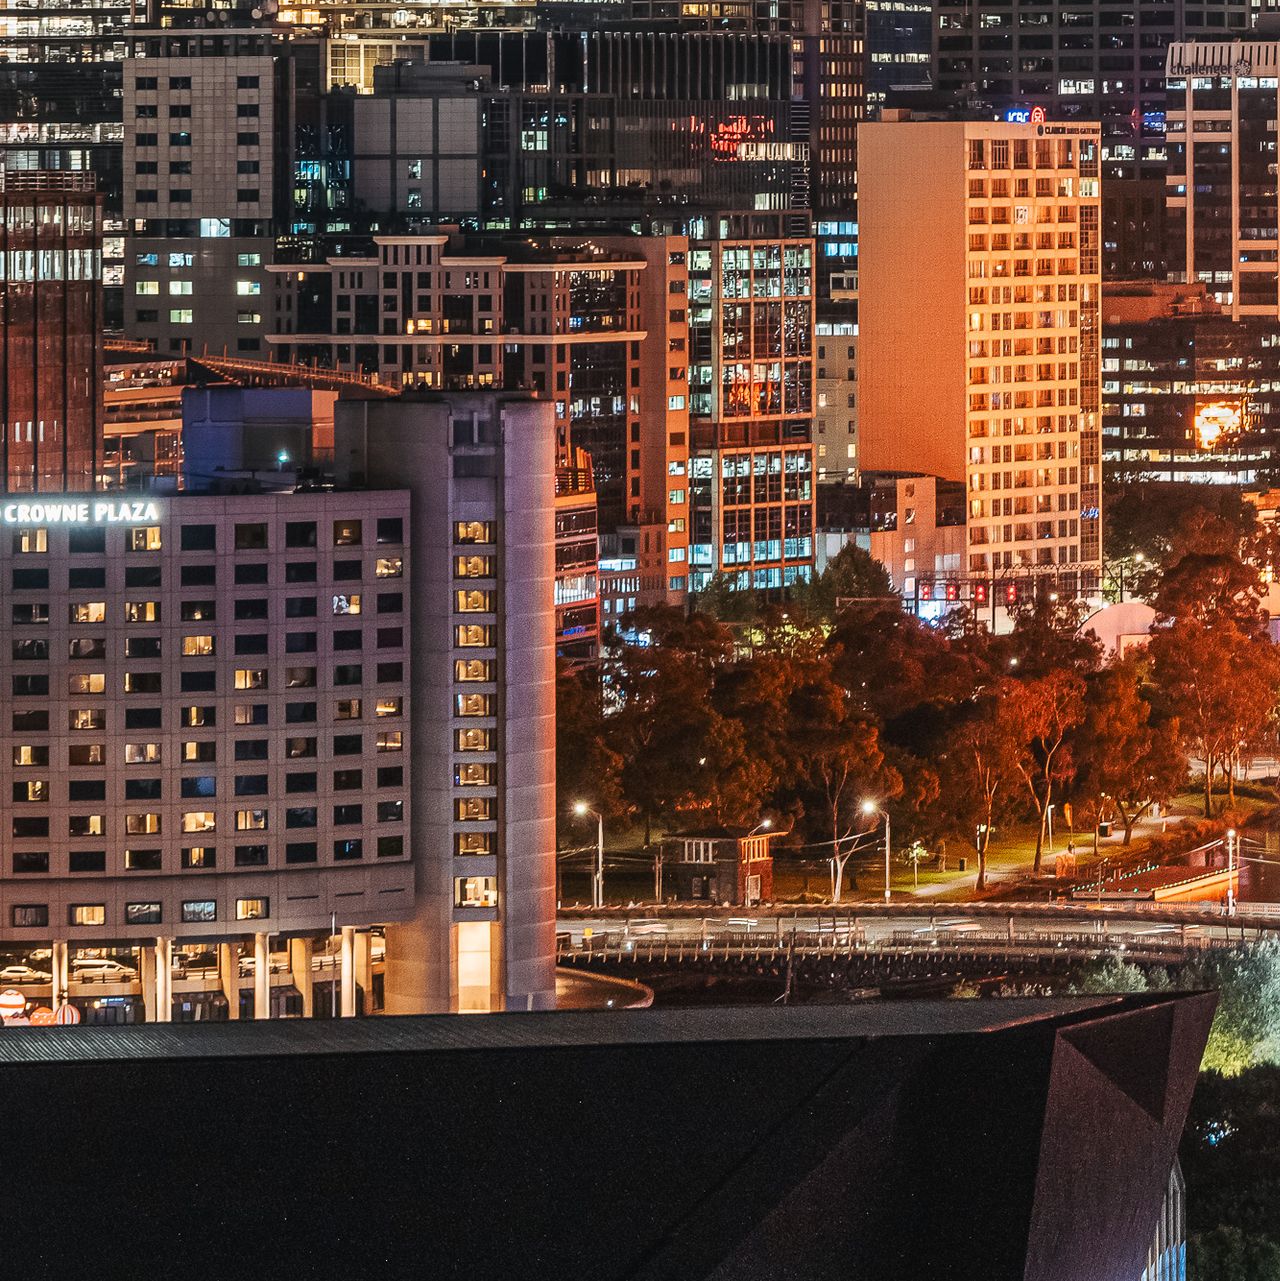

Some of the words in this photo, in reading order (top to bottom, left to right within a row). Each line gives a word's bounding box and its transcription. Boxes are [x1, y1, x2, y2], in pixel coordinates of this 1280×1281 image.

[1170, 61, 1233, 76] challenger
[3, 503, 89, 523] CROWNE
[94, 502, 159, 522] PLAZA
